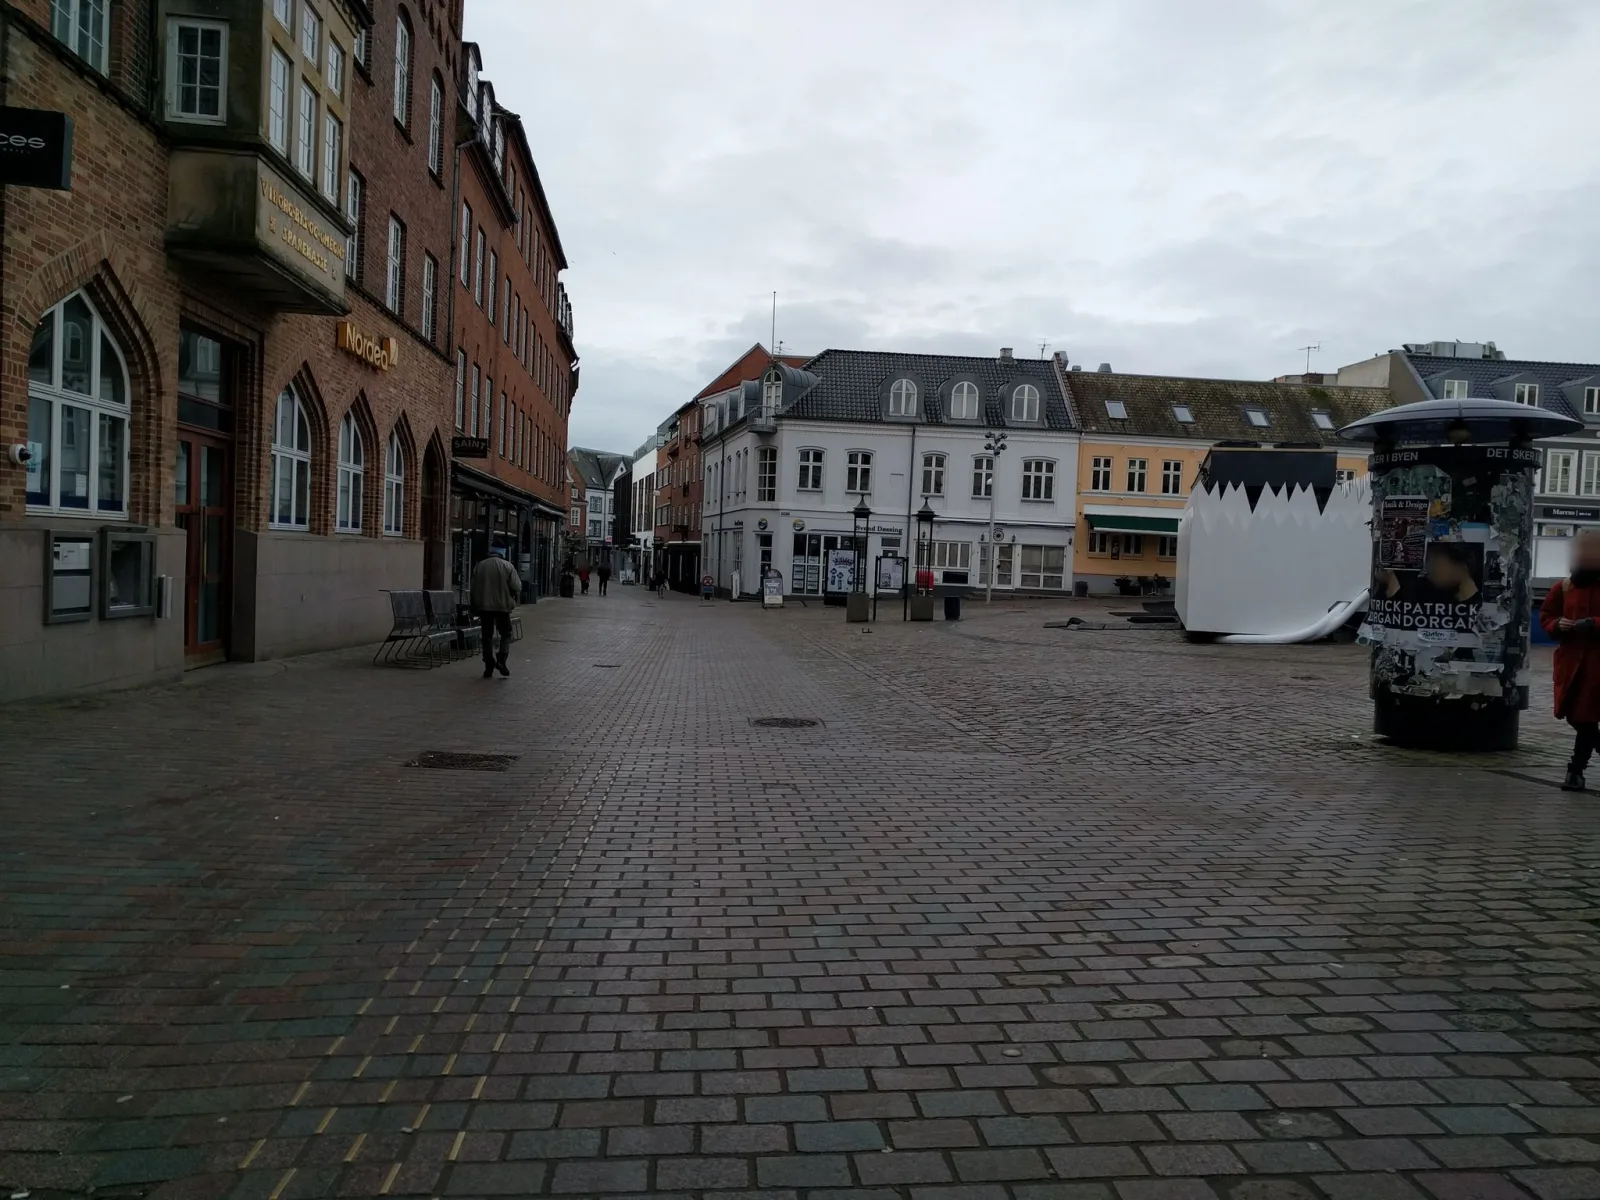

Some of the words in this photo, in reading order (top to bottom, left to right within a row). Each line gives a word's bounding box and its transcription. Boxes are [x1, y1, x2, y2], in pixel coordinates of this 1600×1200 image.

[346, 322, 388, 371] Nordea
[453, 439, 487, 450] SAINT
[1391, 451, 1419, 462] BYEN
[1486, 447, 1511, 459] DET
[1512, 449, 1535, 462] SKER
[1405, 501, 1428, 511] Design
[1403, 602, 1478, 616] PATRICK
[1403, 615, 1477, 629] DORGAN
